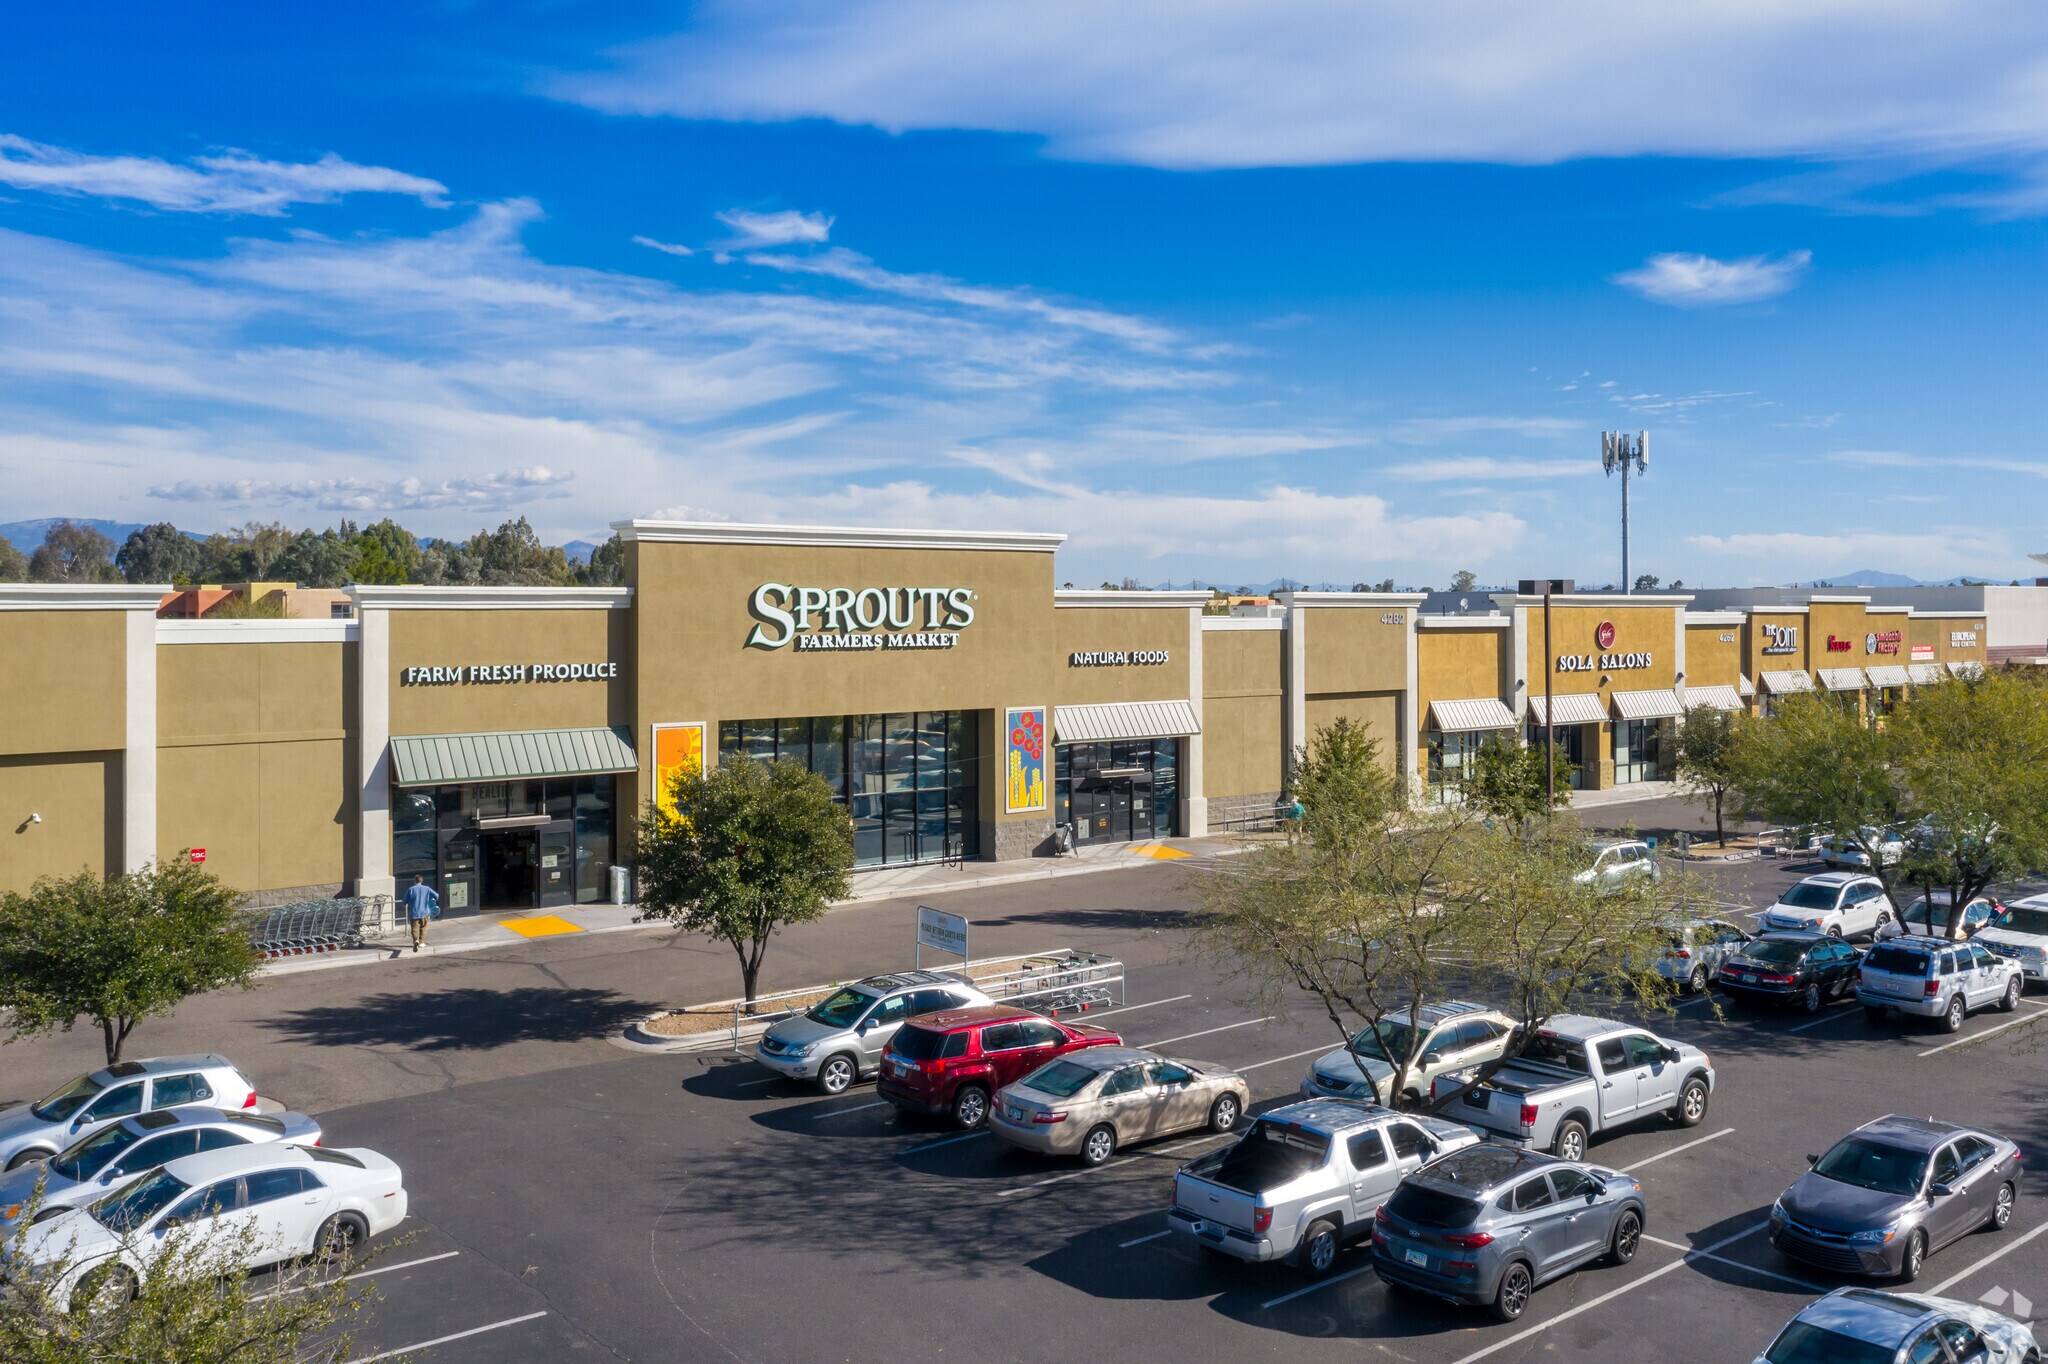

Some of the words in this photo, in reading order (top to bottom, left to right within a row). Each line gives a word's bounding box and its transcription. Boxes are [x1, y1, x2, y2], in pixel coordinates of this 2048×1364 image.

[750, 582, 975, 647] SPROUTS
[1381, 613, 1404, 624] 4282
[800, 634, 882, 649] FARMERS
[888, 632, 959, 647] MARKET
[1773, 627, 1797, 647] JOINT
[1074, 651, 1129, 664] NATURAL
[1133, 651, 1169, 663] FOODS
[1559, 655, 1595, 670] SOLA
[1601, 653, 1652, 669] SALONS
[408, 667, 462, 683] FARM
[470, 665, 525, 681] FRESH
[532, 662, 617, 679] PRODUCE
